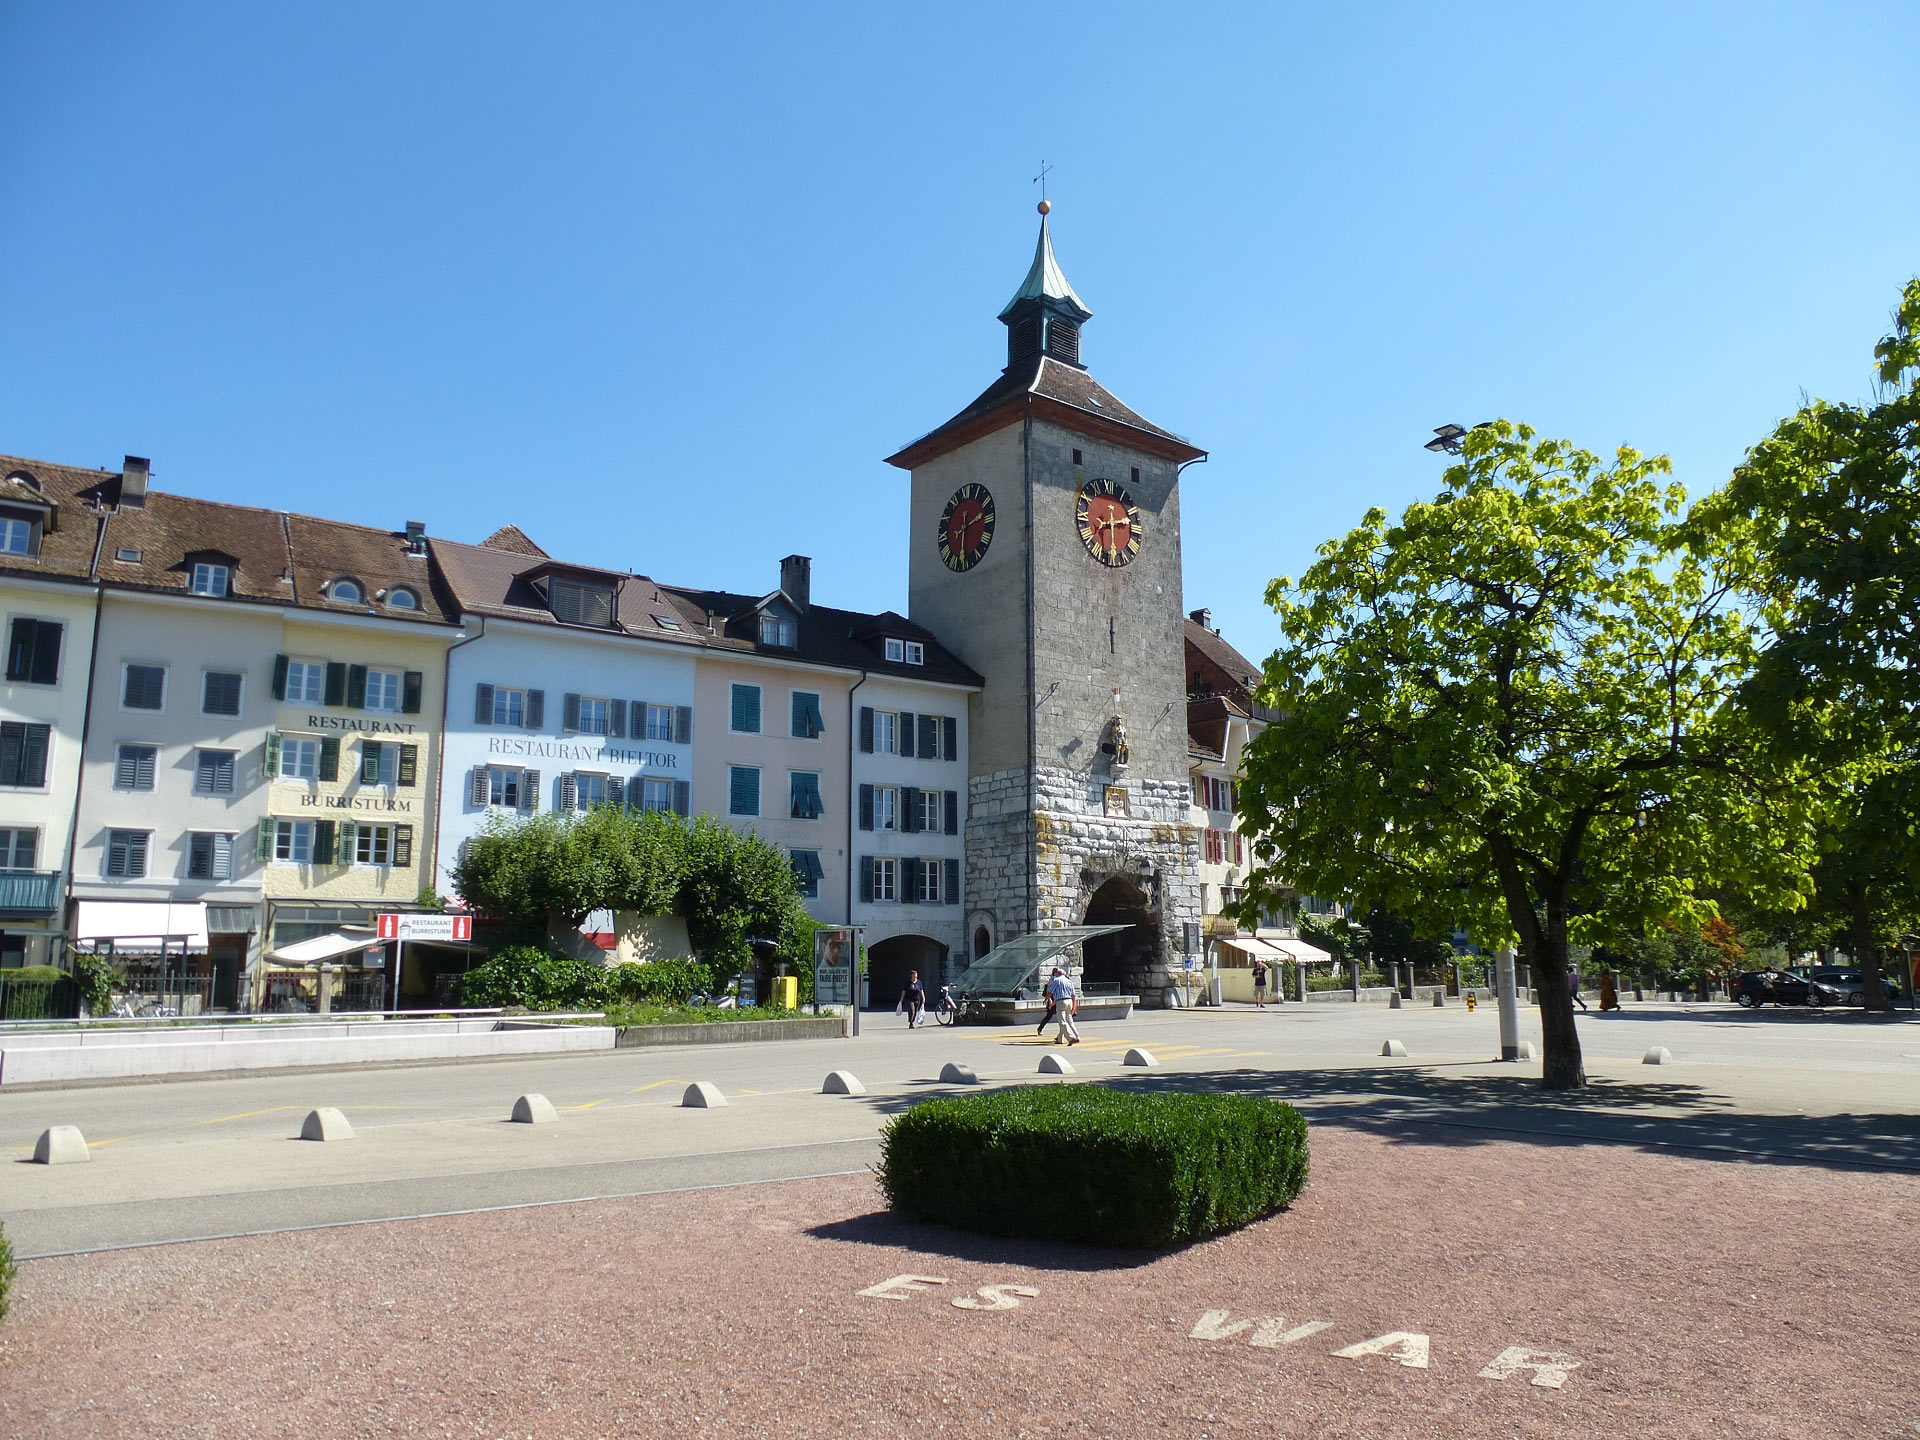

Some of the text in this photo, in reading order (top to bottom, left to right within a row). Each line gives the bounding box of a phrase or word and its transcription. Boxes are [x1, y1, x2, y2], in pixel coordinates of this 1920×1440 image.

[1127, 506, 1138, 516] II
[1131, 524, 1142, 534] III
[308, 715, 416, 735] RESTAURANT
[489, 737, 677, 769] RESTAURANT BIELTOR
[301, 794, 411, 812] BURRISTURM
[1188, 1308, 1581, 1390] WAR
